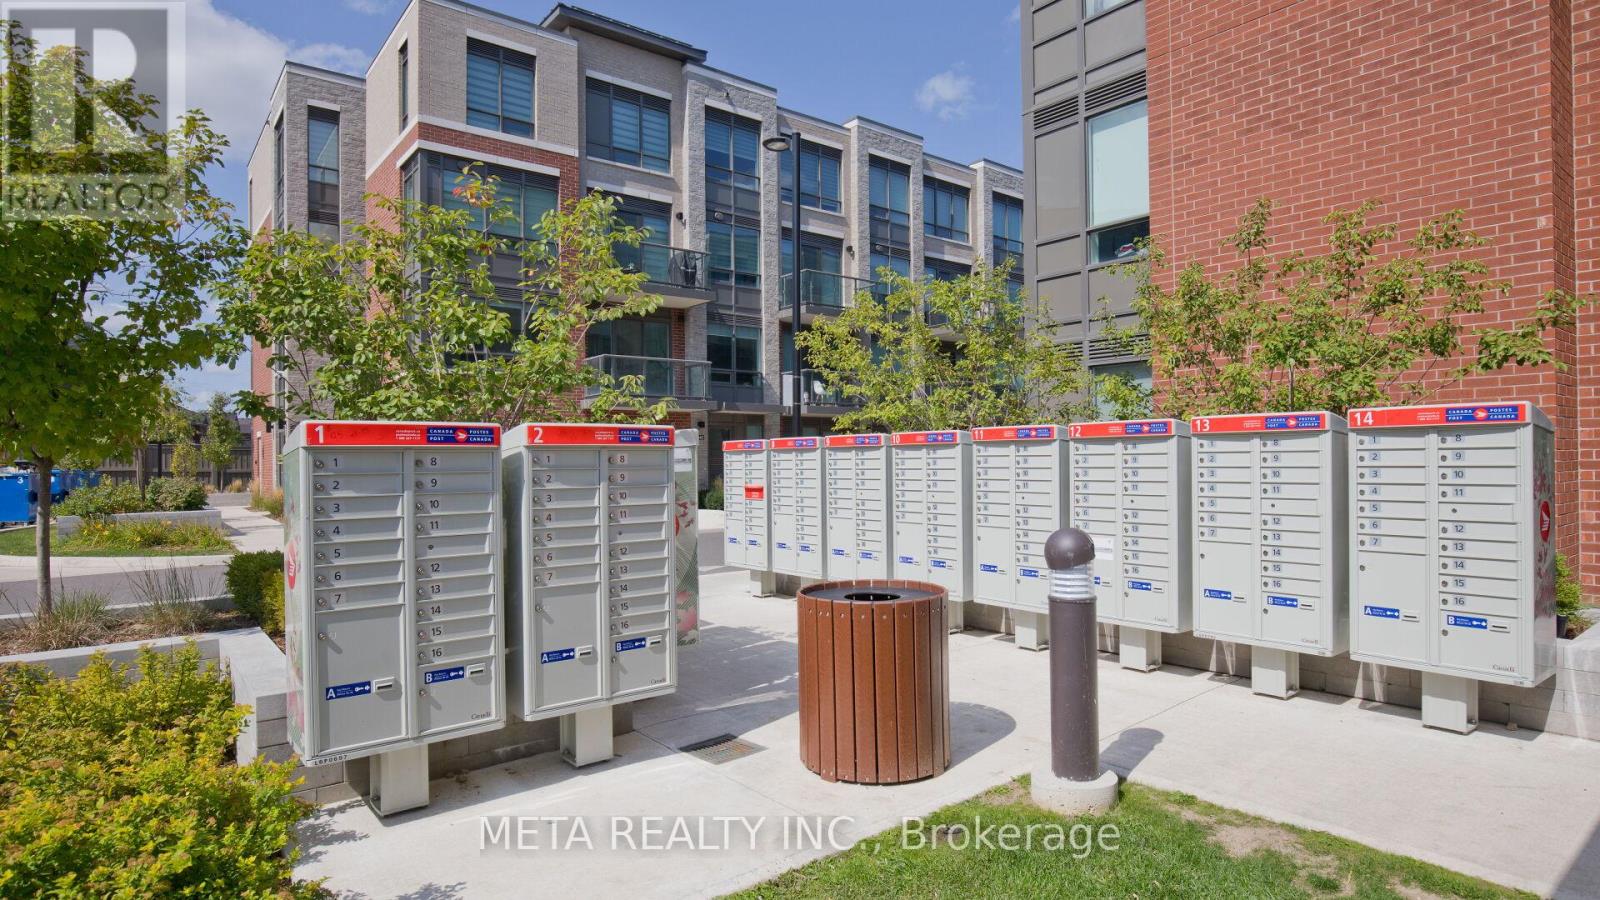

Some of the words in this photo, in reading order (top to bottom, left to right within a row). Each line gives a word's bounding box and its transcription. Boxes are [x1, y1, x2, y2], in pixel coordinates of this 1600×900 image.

[1354, 412, 1374, 426] 14
[1195, 419, 1210, 432] 13
[314, 426, 324, 444] 1
[534, 428, 543, 443] 2
[975, 430, 984, 439] 11
[1070, 426, 1081, 437] 12
[430, 457, 437, 466] 8
[620, 473, 625, 482] 9
[1454, 470, 1464, 478] 10
[430, 478, 438, 487] 9
[546, 475, 552, 483] 2
[332, 480, 339, 490] 2
[547, 494, 552, 502] 3
[333, 503, 340, 512] 3
[430, 499, 439, 508] 10
[546, 513, 552, 522] 4
[620, 510, 626, 518] 11
[430, 521, 438, 529] 11
[333, 526, 340, 535] 4
[547, 533, 552, 541] 5
[619, 547, 627, 555] 12
[1454, 542, 1464, 551] 13
[334, 549, 340, 558] 5
[547, 553, 552, 561] 6
[430, 563, 440, 572] 12
[620, 565, 628, 574] 13
[334, 571, 341, 580] 6
[547, 572, 552, 581] 7
[431, 585, 440, 593] 13
[620, 584, 628, 592] 14
[334, 594, 341, 603] 7
[431, 606, 441, 614] 14
[620, 602, 629, 610] 15
[621, 621, 629, 629] 16
[432, 627, 442, 636] 15
[432, 648, 442, 657] 16
[426, 673, 432, 682] B
[327, 689, 336, 698] A
